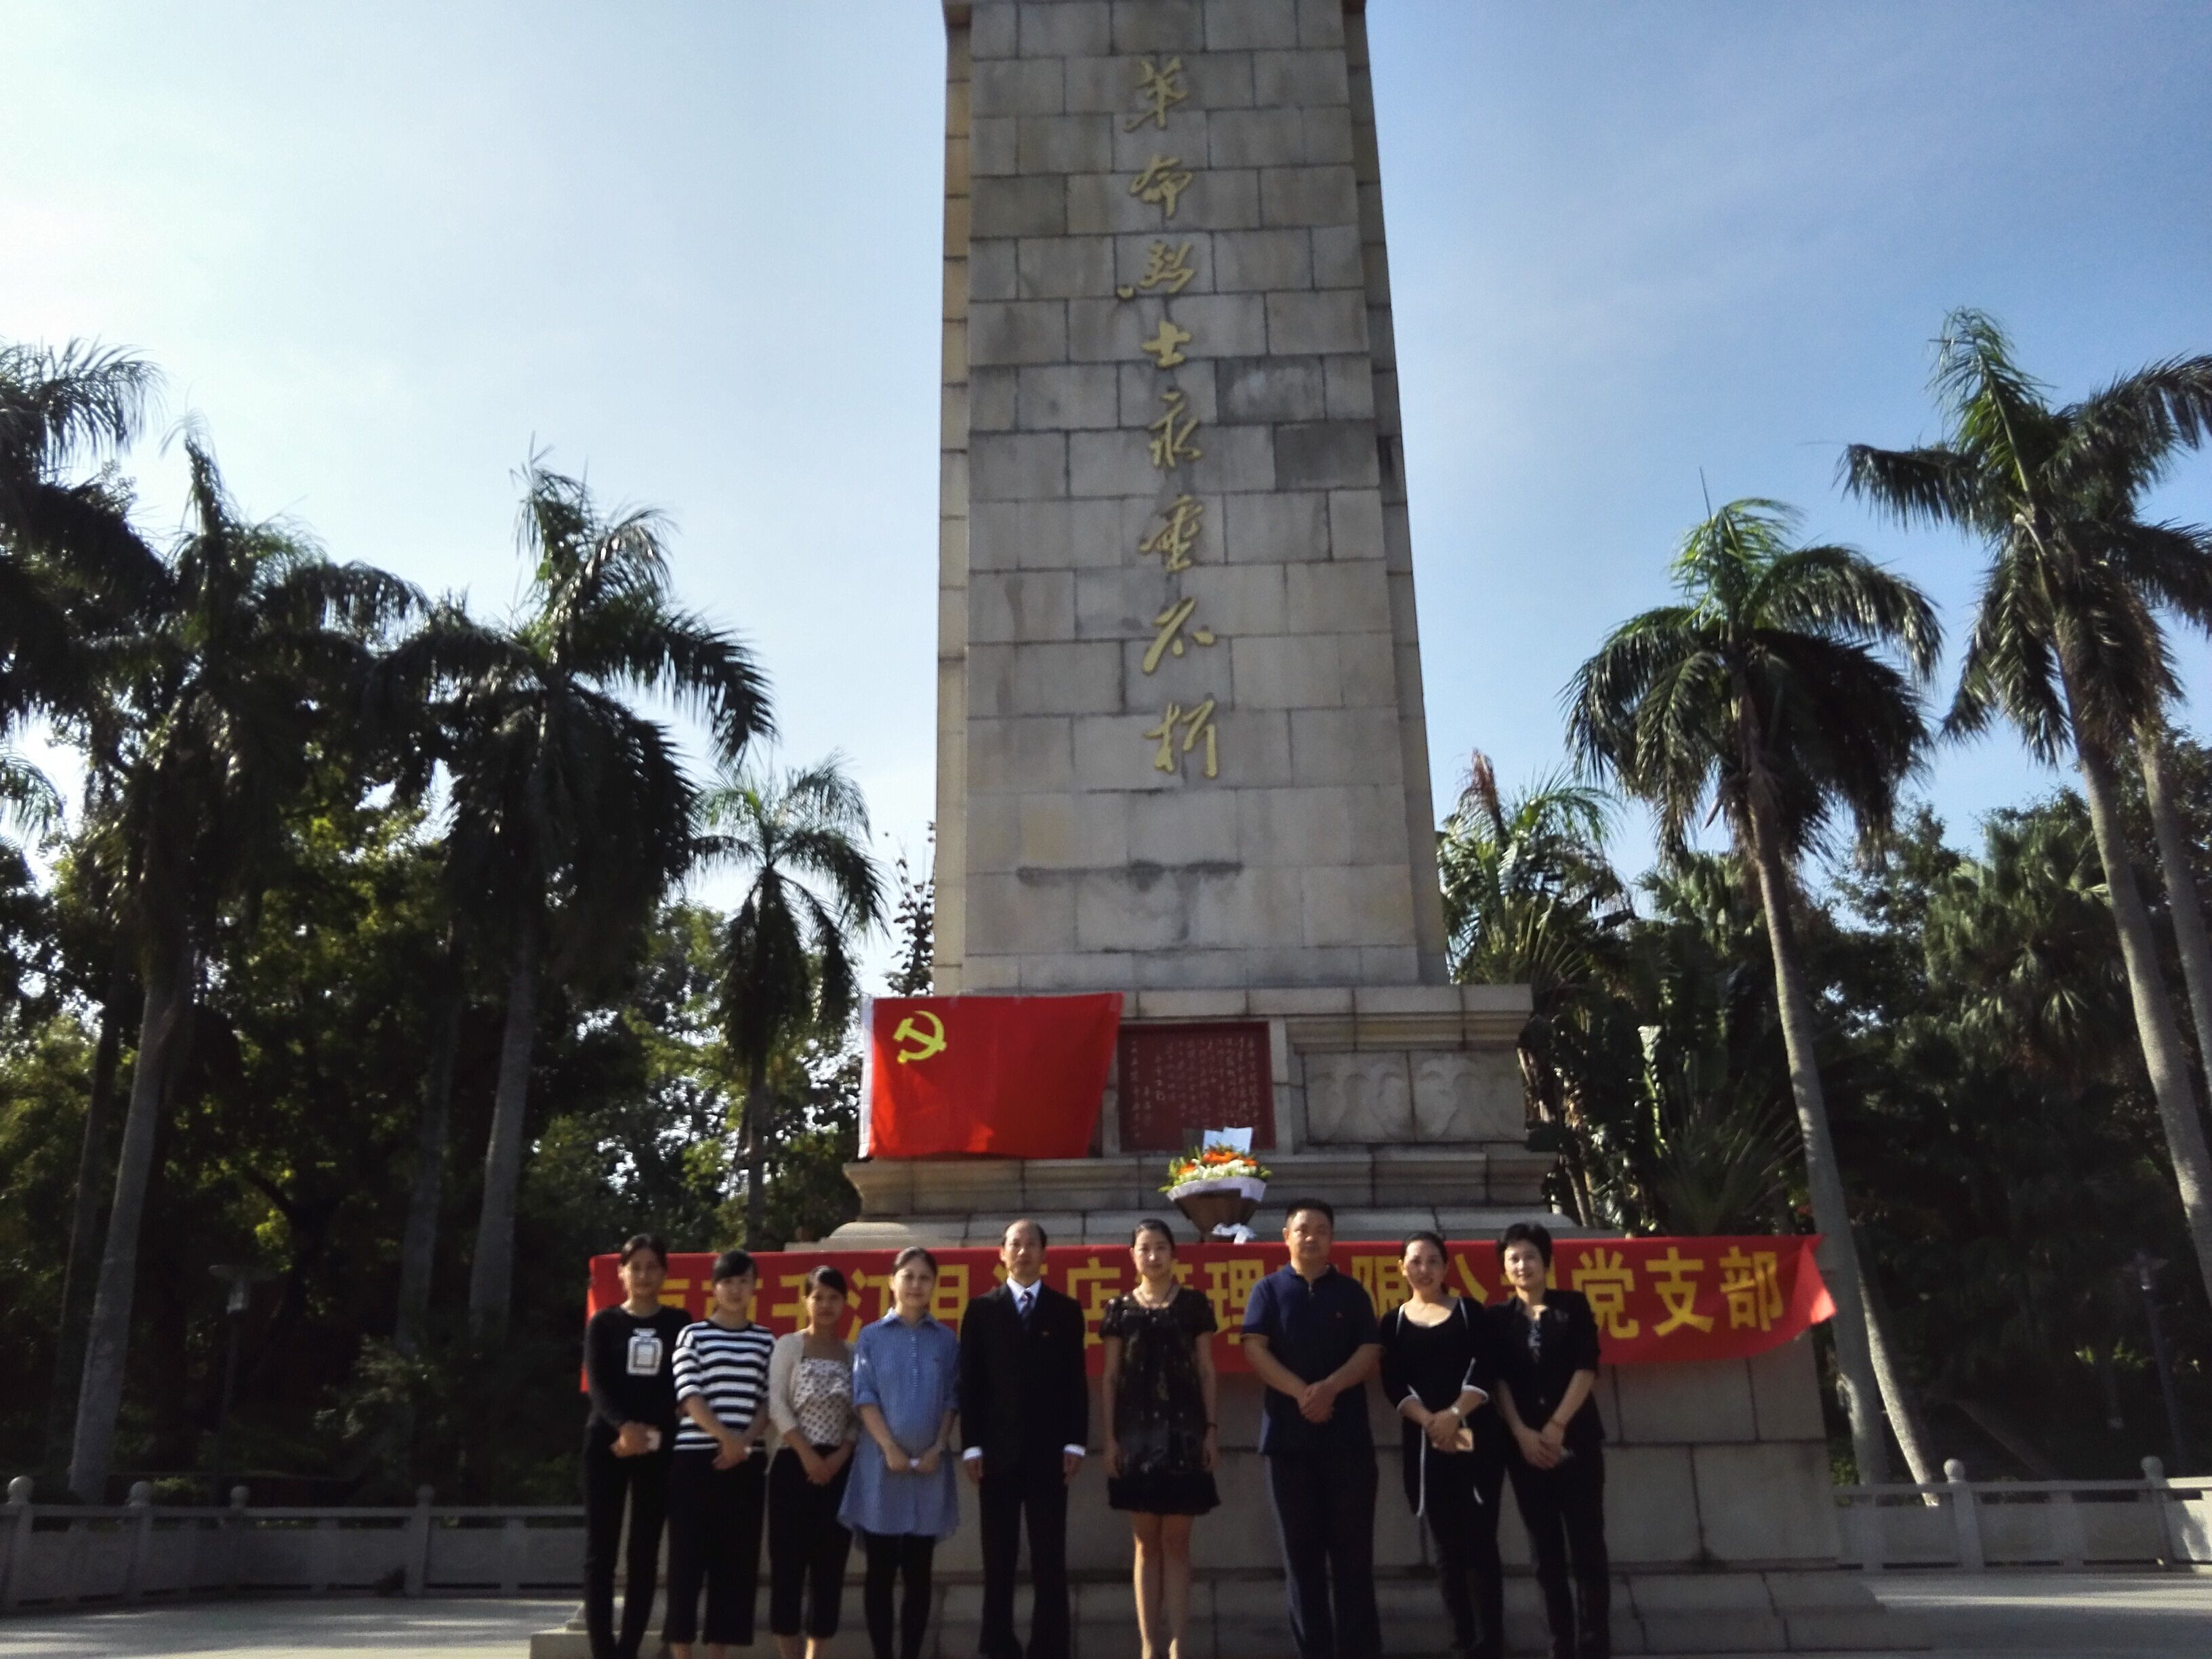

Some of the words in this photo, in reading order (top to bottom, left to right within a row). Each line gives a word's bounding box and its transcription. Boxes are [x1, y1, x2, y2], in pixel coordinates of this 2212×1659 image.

[1117, 56, 1218, 778] 革命烈士永垂不朽
